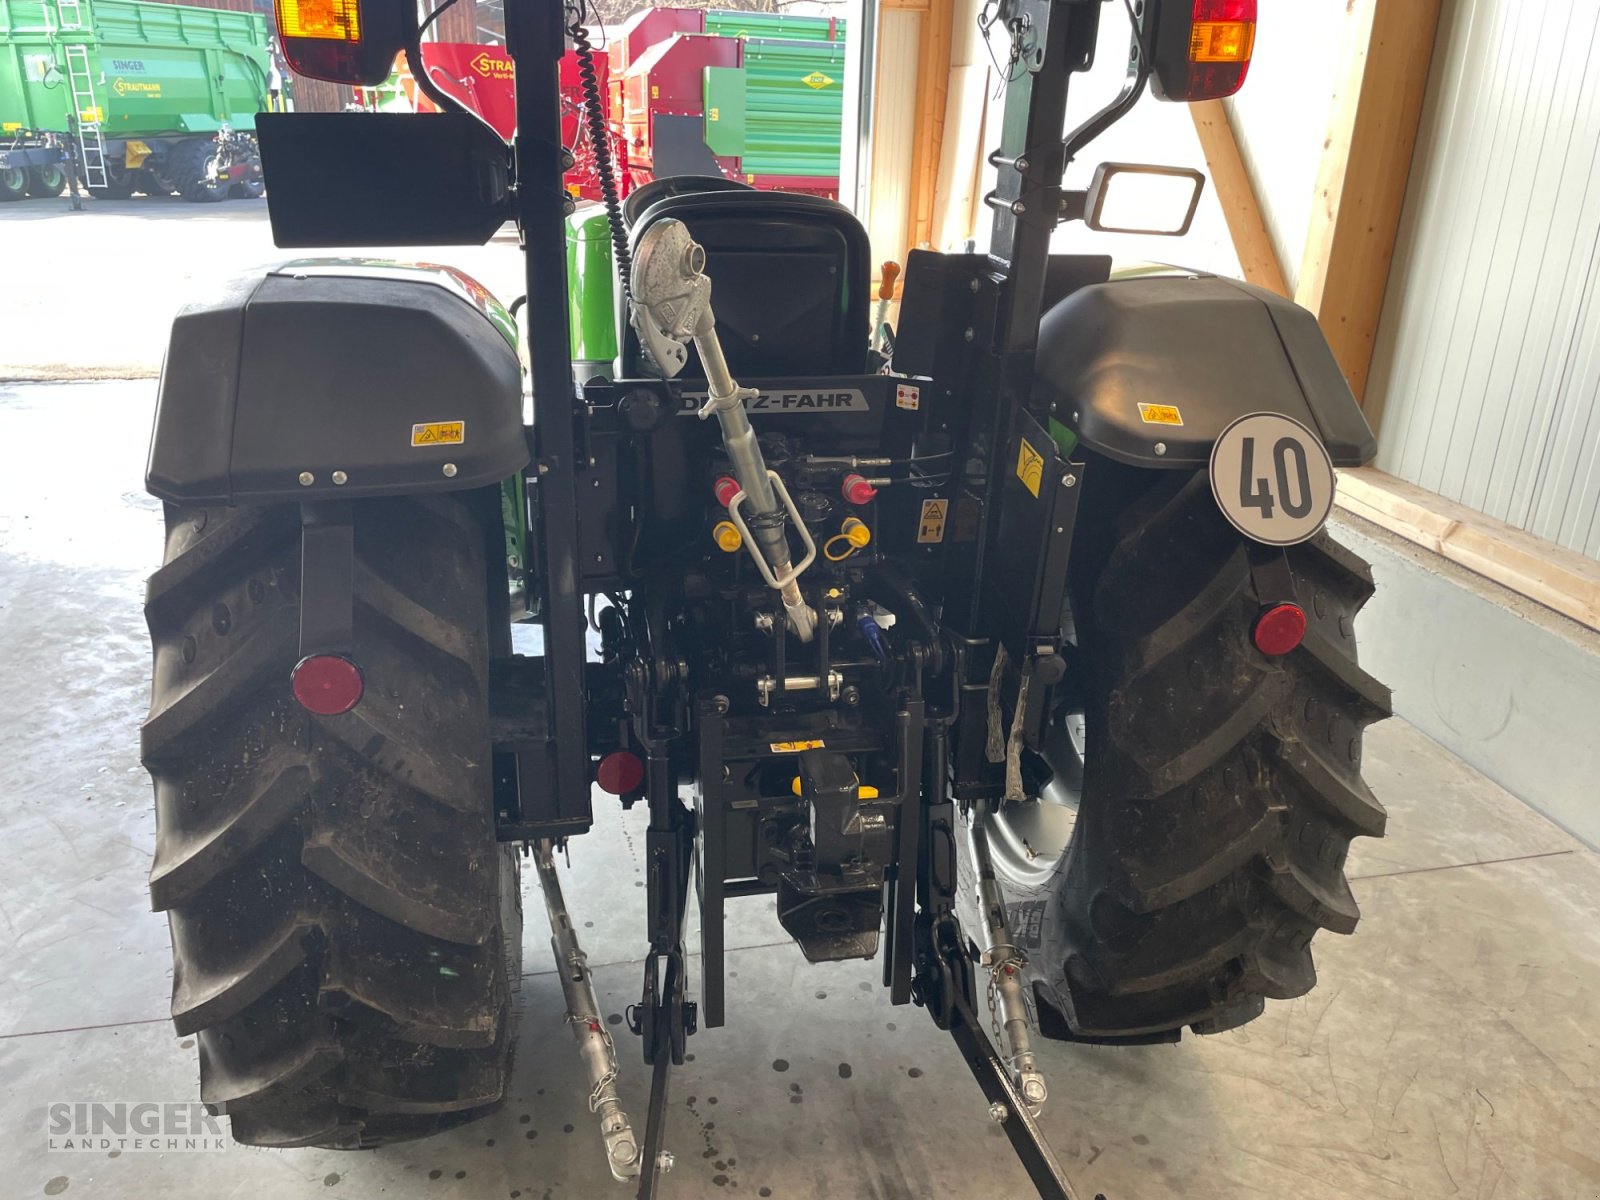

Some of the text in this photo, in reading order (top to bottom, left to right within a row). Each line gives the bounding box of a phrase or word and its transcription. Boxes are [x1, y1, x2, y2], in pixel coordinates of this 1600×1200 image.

[113, 60, 145, 70] SINGER
[682, 393, 852, 410] DTZ-FAHR
[1239, 436, 1312, 519] 40
